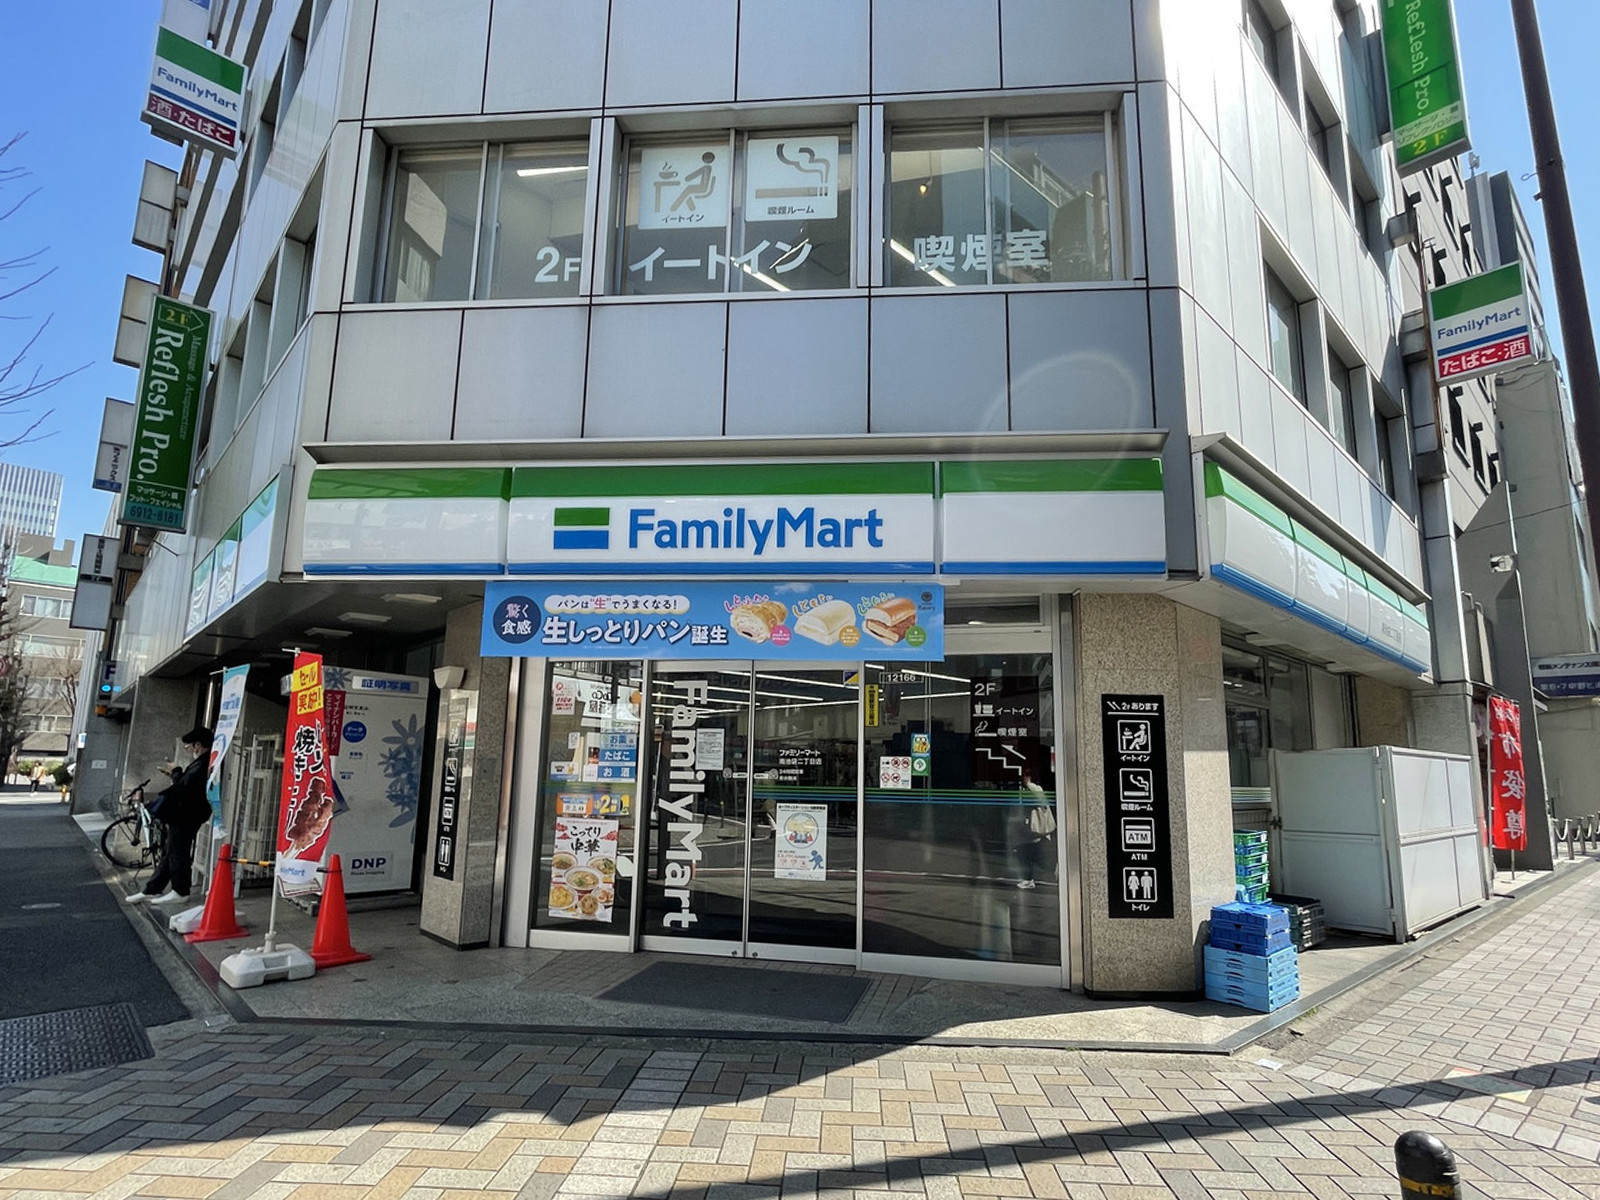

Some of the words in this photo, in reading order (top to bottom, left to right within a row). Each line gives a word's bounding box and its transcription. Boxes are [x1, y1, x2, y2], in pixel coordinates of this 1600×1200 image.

[1405, 0, 1430, 74] Reflesh
[157, 67, 238, 112] FamilyMart
[1414, 75, 1430, 116] Pro.
[661, 214, 705, 223] イートイン
[535, 246, 582, 283] 2F
[629, 239, 812, 282] イートイン
[913, 229, 1050, 272] 喫煙室
[1438, 307, 1521, 339] FamilyMart
[1441, 339, 1526, 375] たばこ・酒
[145, 326, 184, 422] Reflesh
[137, 429, 170, 480] Pro.
[629, 507, 884, 555] FamilyMart
[506, 603, 529, 619] 驚く
[501, 620, 532, 636] 食感
[975, 683, 996, 696] 2F
[996, 707, 1034, 716] イートイン
[998, 727, 1027, 737] 喫煙室
[604, 751, 630, 760] たばこ
[779, 749, 821, 757] ファミリーマート
[659, 680, 708, 928] FamilyMart
[570, 826, 601, 837] こってり
[1128, 833, 1149, 841] ATM
[570, 838, 600, 857] 中華
[352, 857, 387, 869] DNP
[1131, 903, 1150, 911] トイレ
